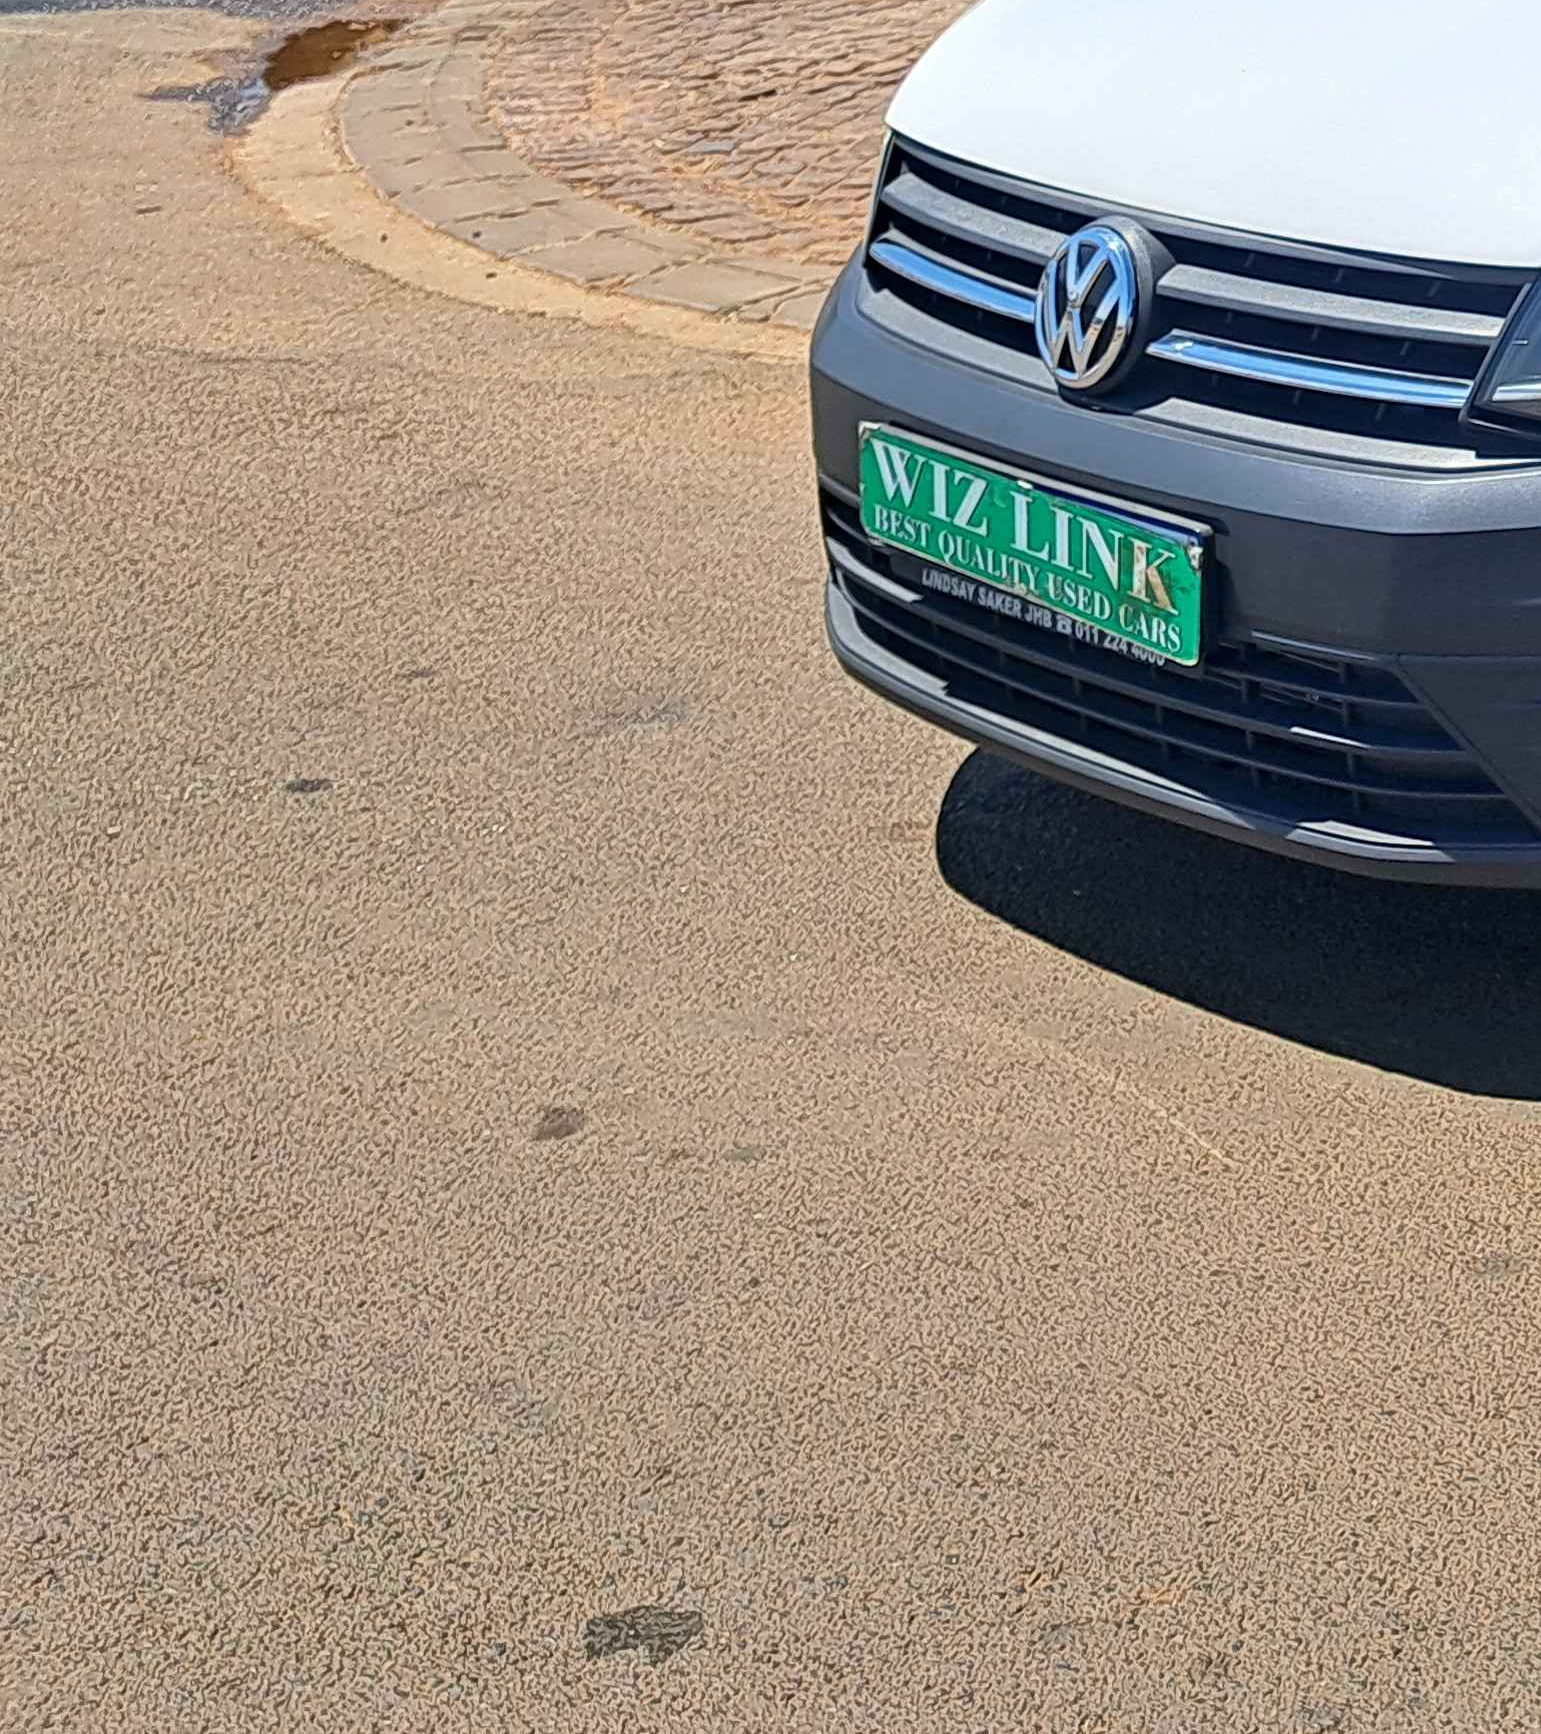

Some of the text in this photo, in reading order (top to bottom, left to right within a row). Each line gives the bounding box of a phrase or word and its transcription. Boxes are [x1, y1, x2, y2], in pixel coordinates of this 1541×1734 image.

[870, 437, 1180, 616] WIZ LINK
[873, 503, 1182, 654] BEST QUALITY USED CARS
[921, 568, 976, 603] LINDSAY
